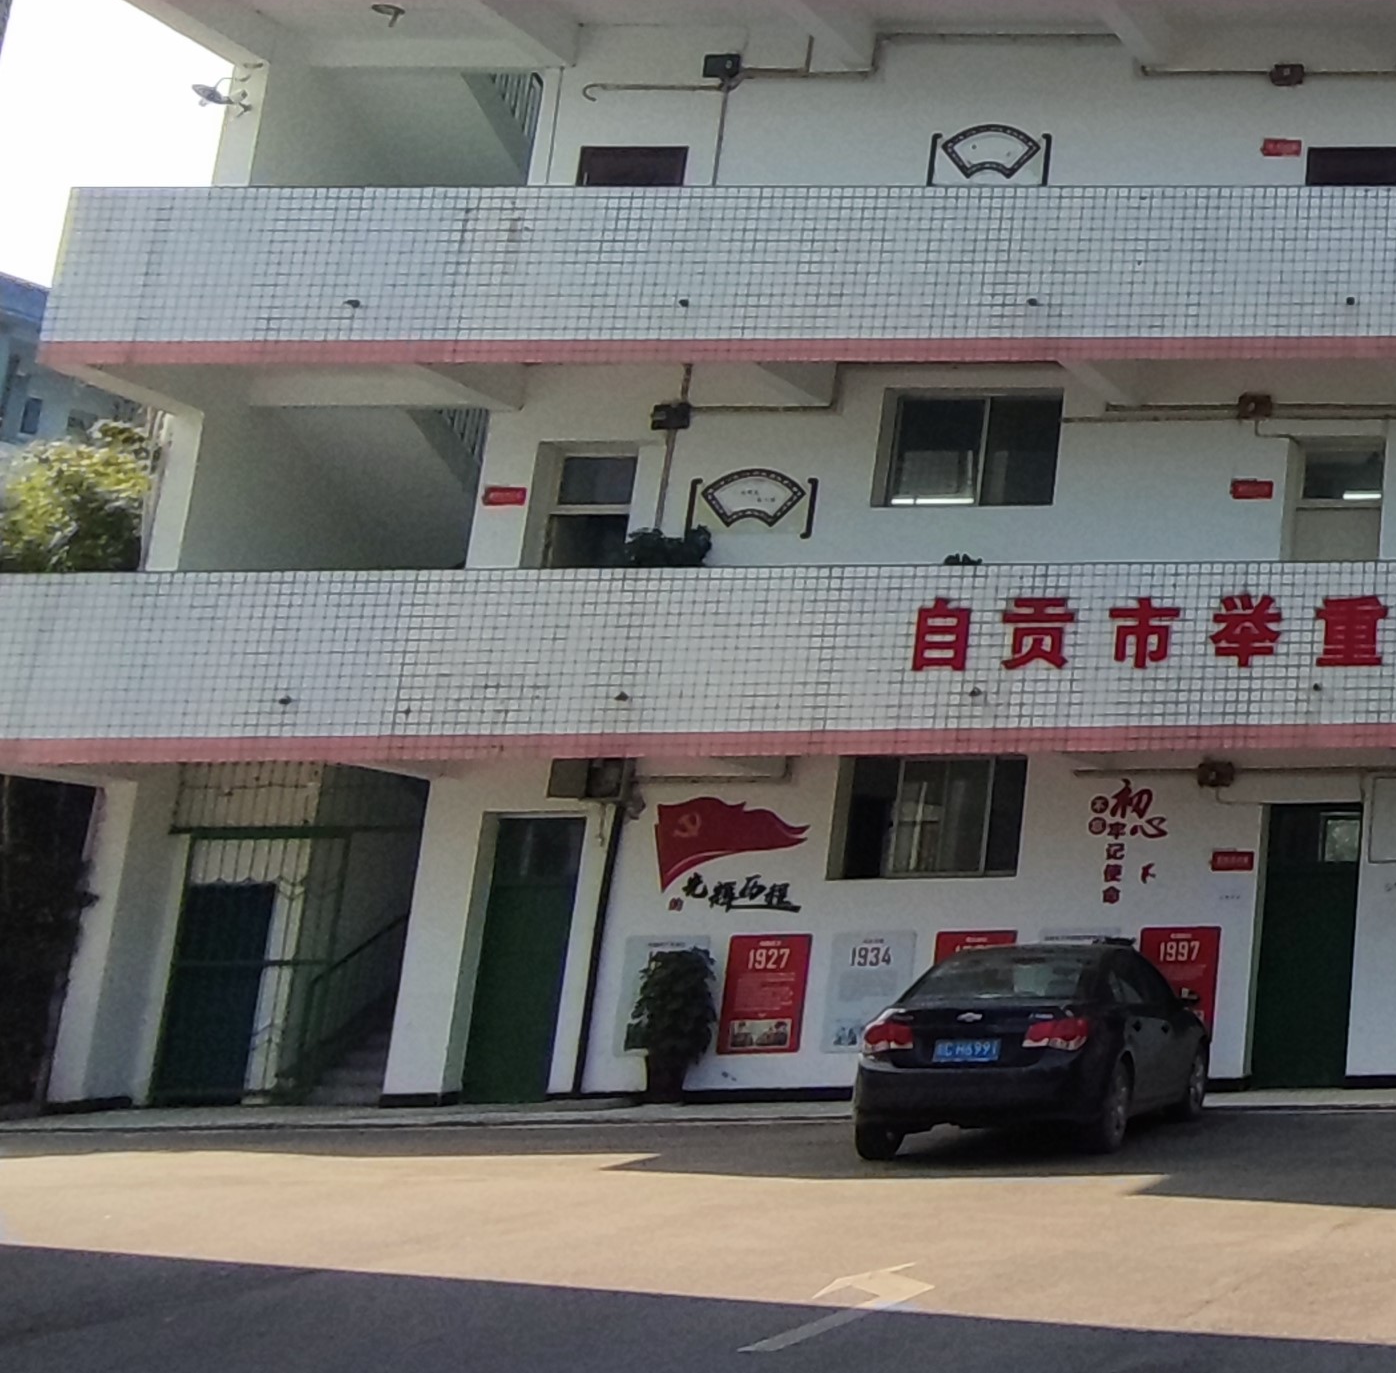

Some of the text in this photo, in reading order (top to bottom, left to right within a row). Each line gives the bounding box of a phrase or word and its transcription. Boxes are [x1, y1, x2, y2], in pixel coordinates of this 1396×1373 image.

[748, 947, 790, 970] 1927
[850, 946, 891, 967] 1934
[1159, 941, 1200, 962] 1997
